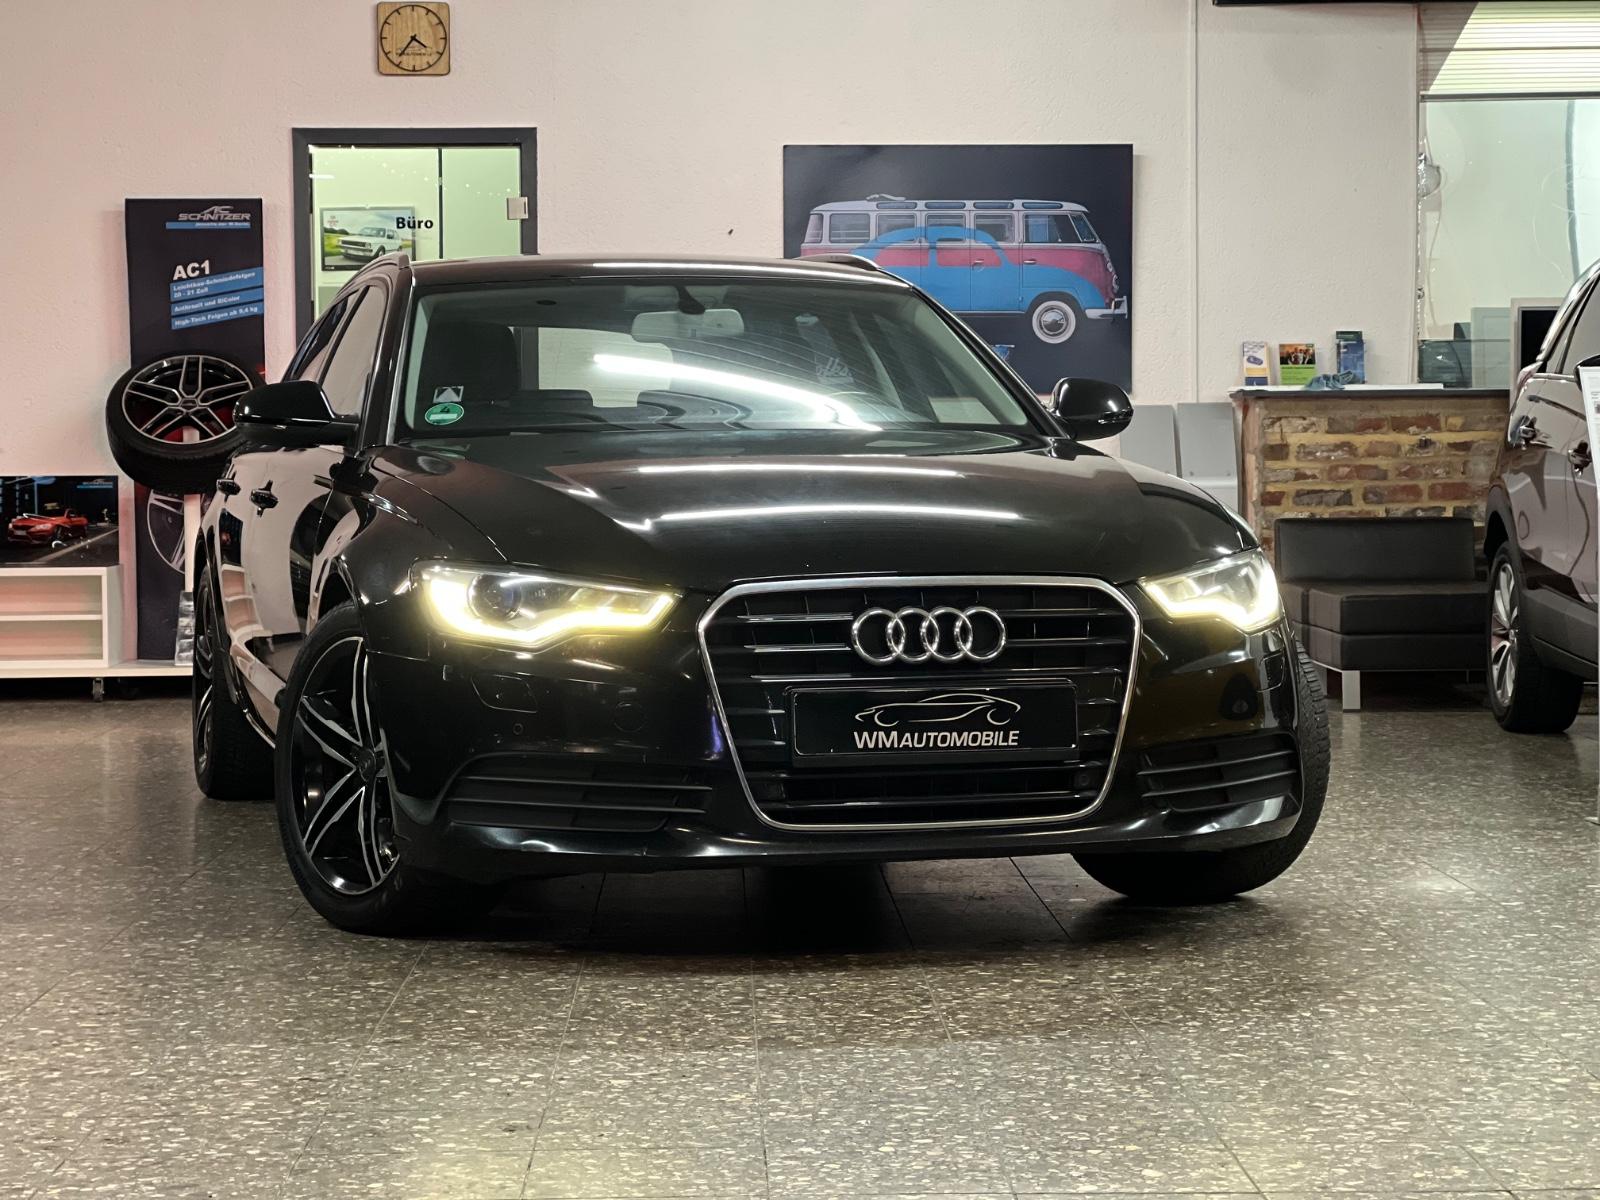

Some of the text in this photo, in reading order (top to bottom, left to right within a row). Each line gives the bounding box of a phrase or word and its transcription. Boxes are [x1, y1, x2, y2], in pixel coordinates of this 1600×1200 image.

[396, 216, 434, 229] Büro
[173, 259, 210, 280] AC1
[207, 311, 228, 321] Felgen
